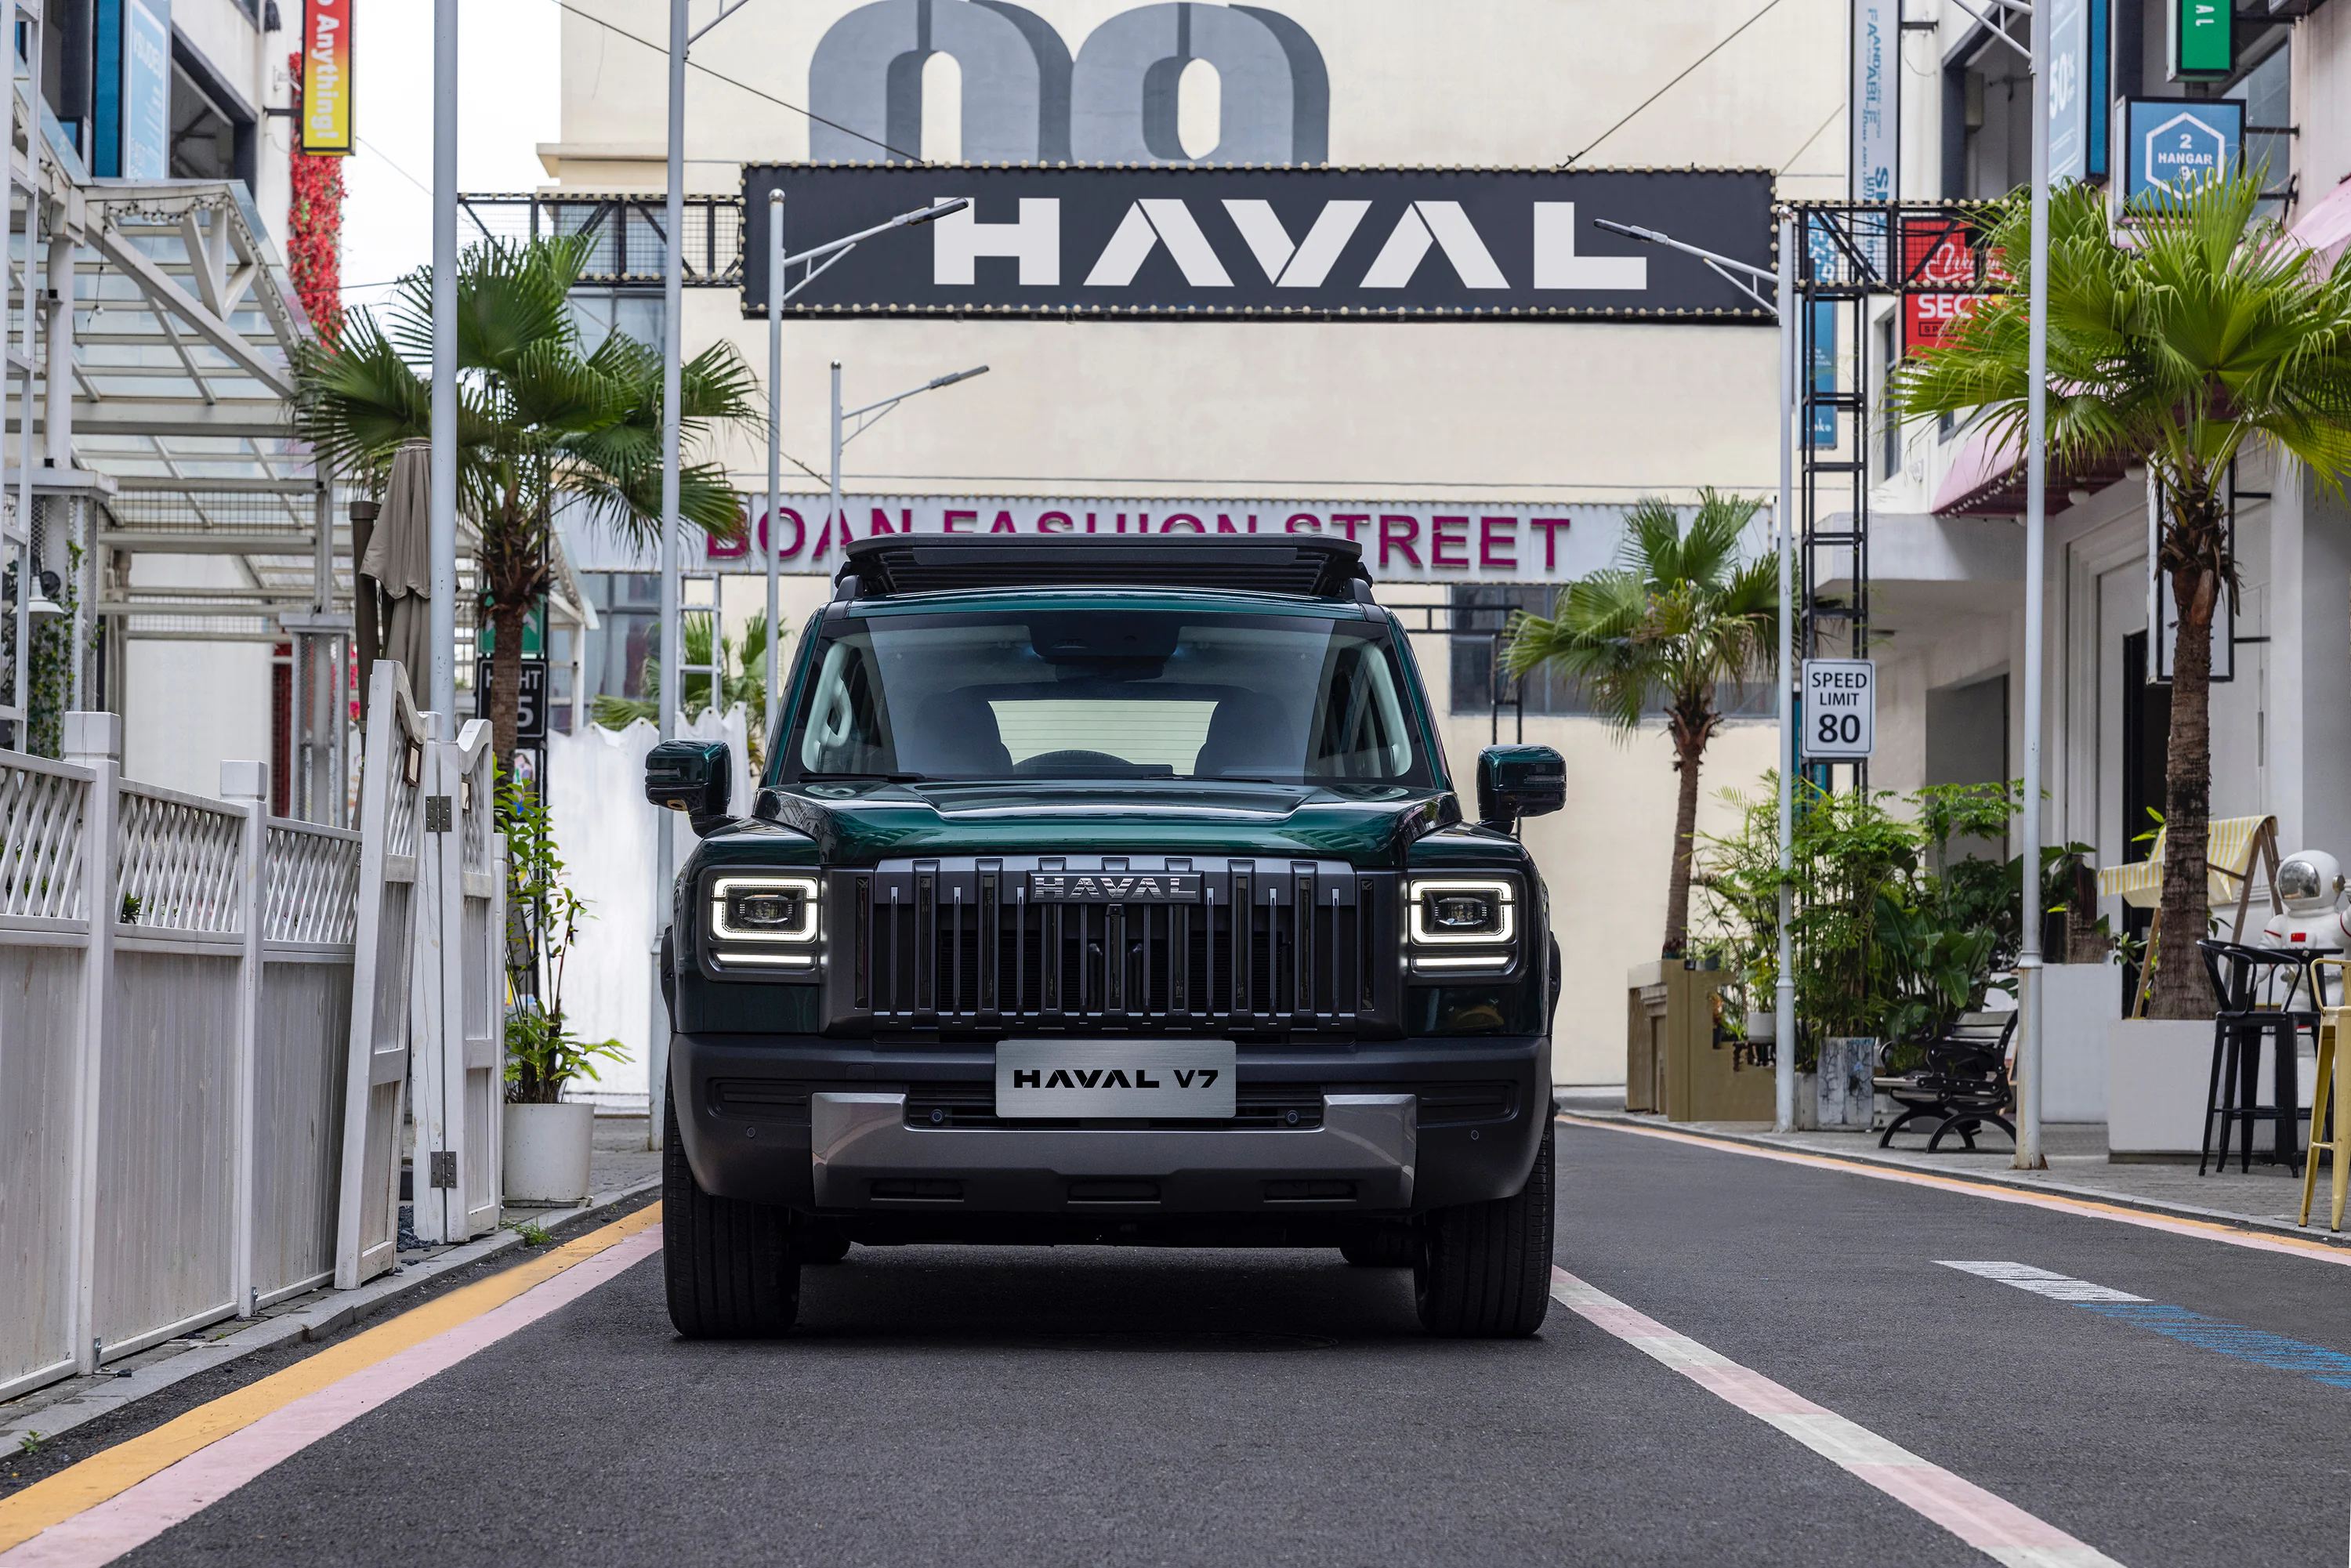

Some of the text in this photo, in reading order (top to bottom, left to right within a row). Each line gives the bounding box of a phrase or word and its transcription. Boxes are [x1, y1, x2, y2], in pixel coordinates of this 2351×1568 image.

[311, 13, 339, 139] Anything!
[2179, 133, 2193, 149] 2
[2157, 152, 2213, 165] HANGAR
[933, 197, 1647, 290] HAVAL
[1812, 672, 1867, 689] SPEED
[1820, 692, 1859, 706] LIMIT
[1818, 714, 1860, 743] 80
[1034, 878, 1197, 899] HAVAL
[1013, 1070, 1219, 1088] HAVAL V7
